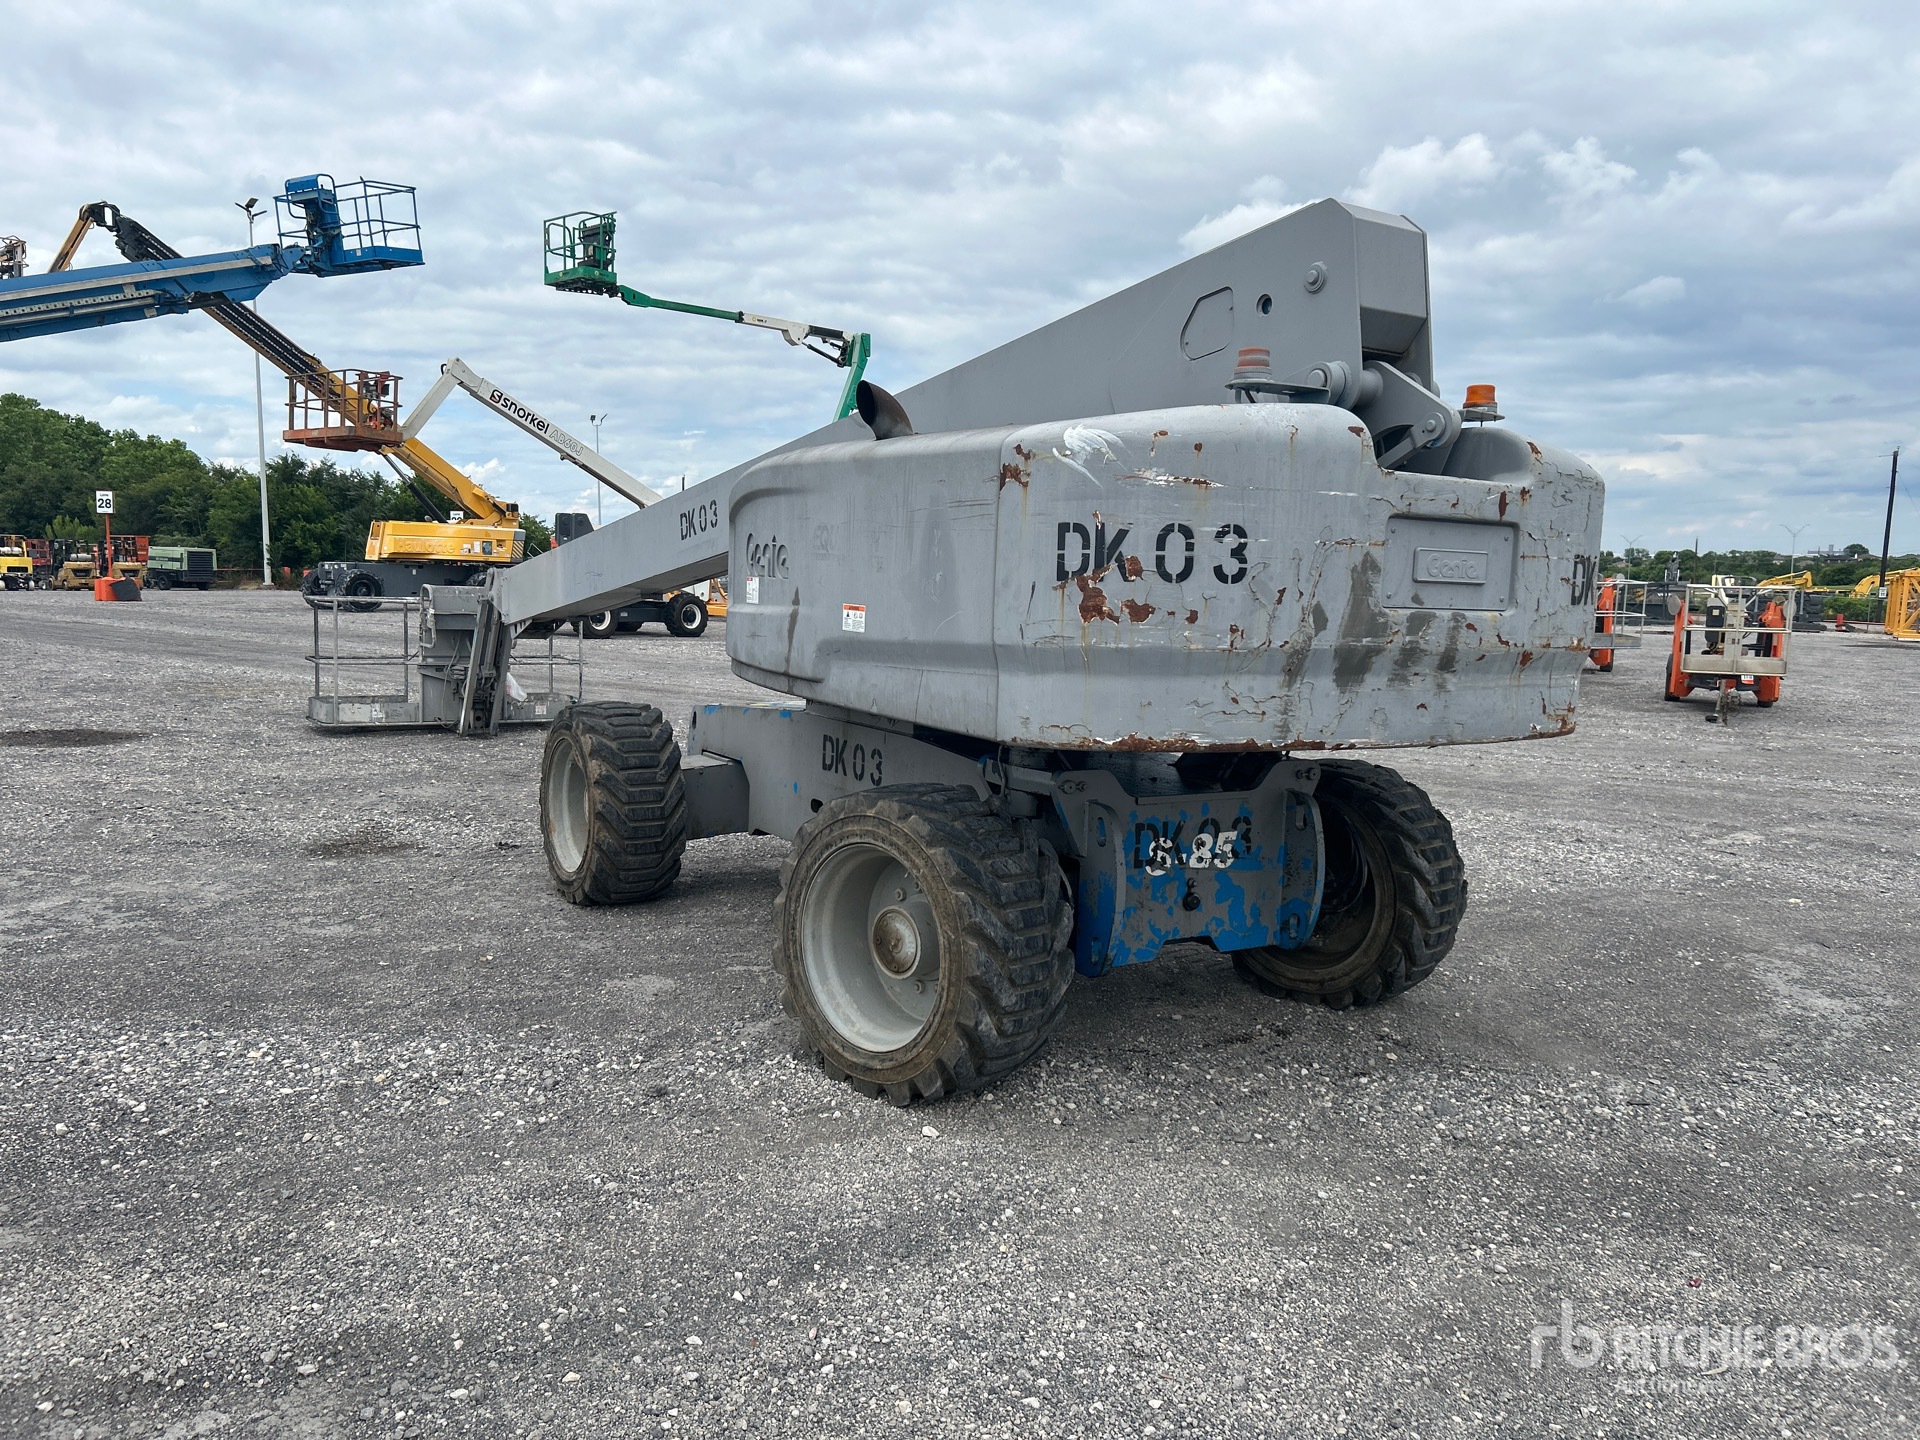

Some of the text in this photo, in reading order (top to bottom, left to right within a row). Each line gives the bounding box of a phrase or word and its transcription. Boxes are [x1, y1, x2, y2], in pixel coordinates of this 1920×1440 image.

[501, 397, 550, 434] snorkel
[549, 429, 584, 456] AB60J
[97, 498, 112, 509] 28
[746, 533, 789, 579] Genie
[1426, 553, 1479, 580] Genie
